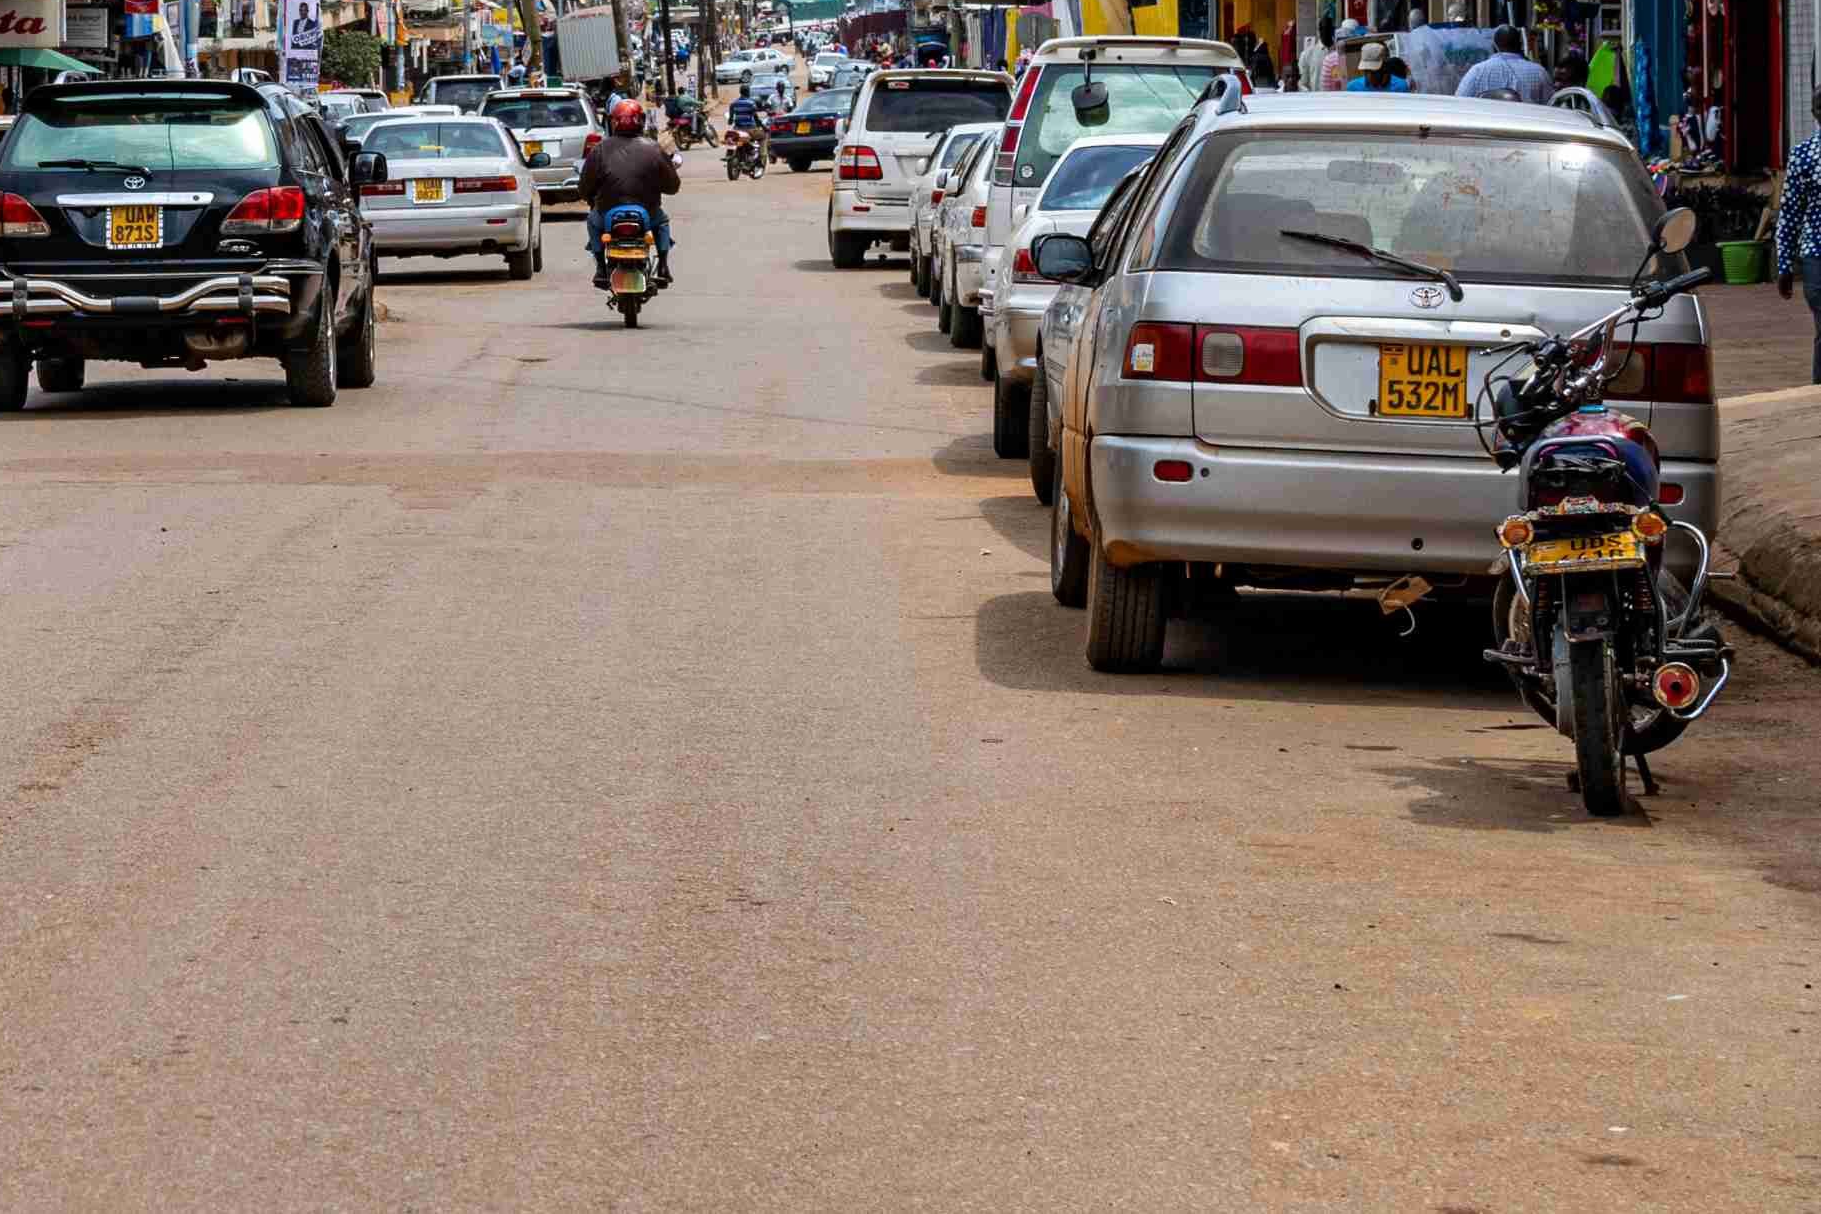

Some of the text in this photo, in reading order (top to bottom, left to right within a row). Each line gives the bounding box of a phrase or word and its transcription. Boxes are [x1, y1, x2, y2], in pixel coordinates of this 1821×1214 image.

[114, 224, 155, 242] 871S
[1406, 344, 1462, 378] UAL
[1386, 383, 1462, 412] 532M
